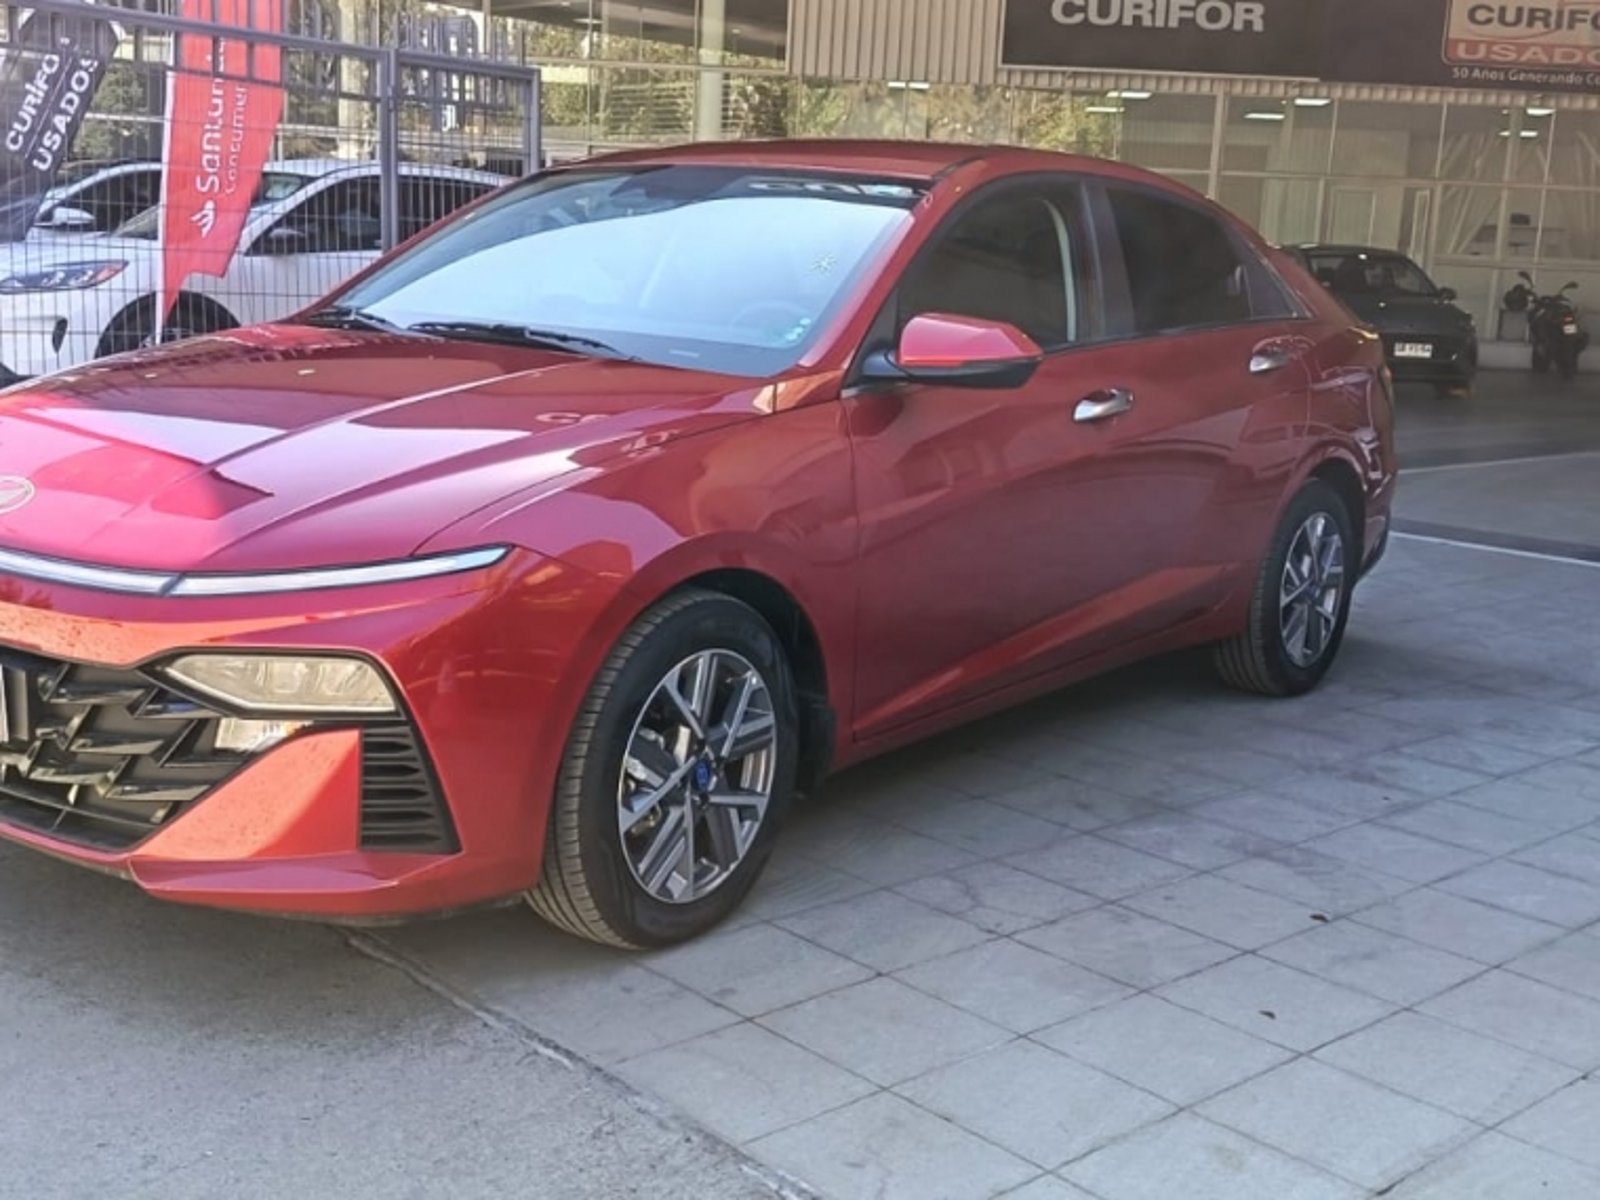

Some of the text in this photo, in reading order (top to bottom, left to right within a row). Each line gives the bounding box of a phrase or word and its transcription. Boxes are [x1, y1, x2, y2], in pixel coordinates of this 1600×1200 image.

[1051, 0, 1265, 32] CURIFOR
[1452, 67, 1469, 79] 50
[1508, 69, 1583, 85] Generando
[5, 37, 72, 151] CURIFO
